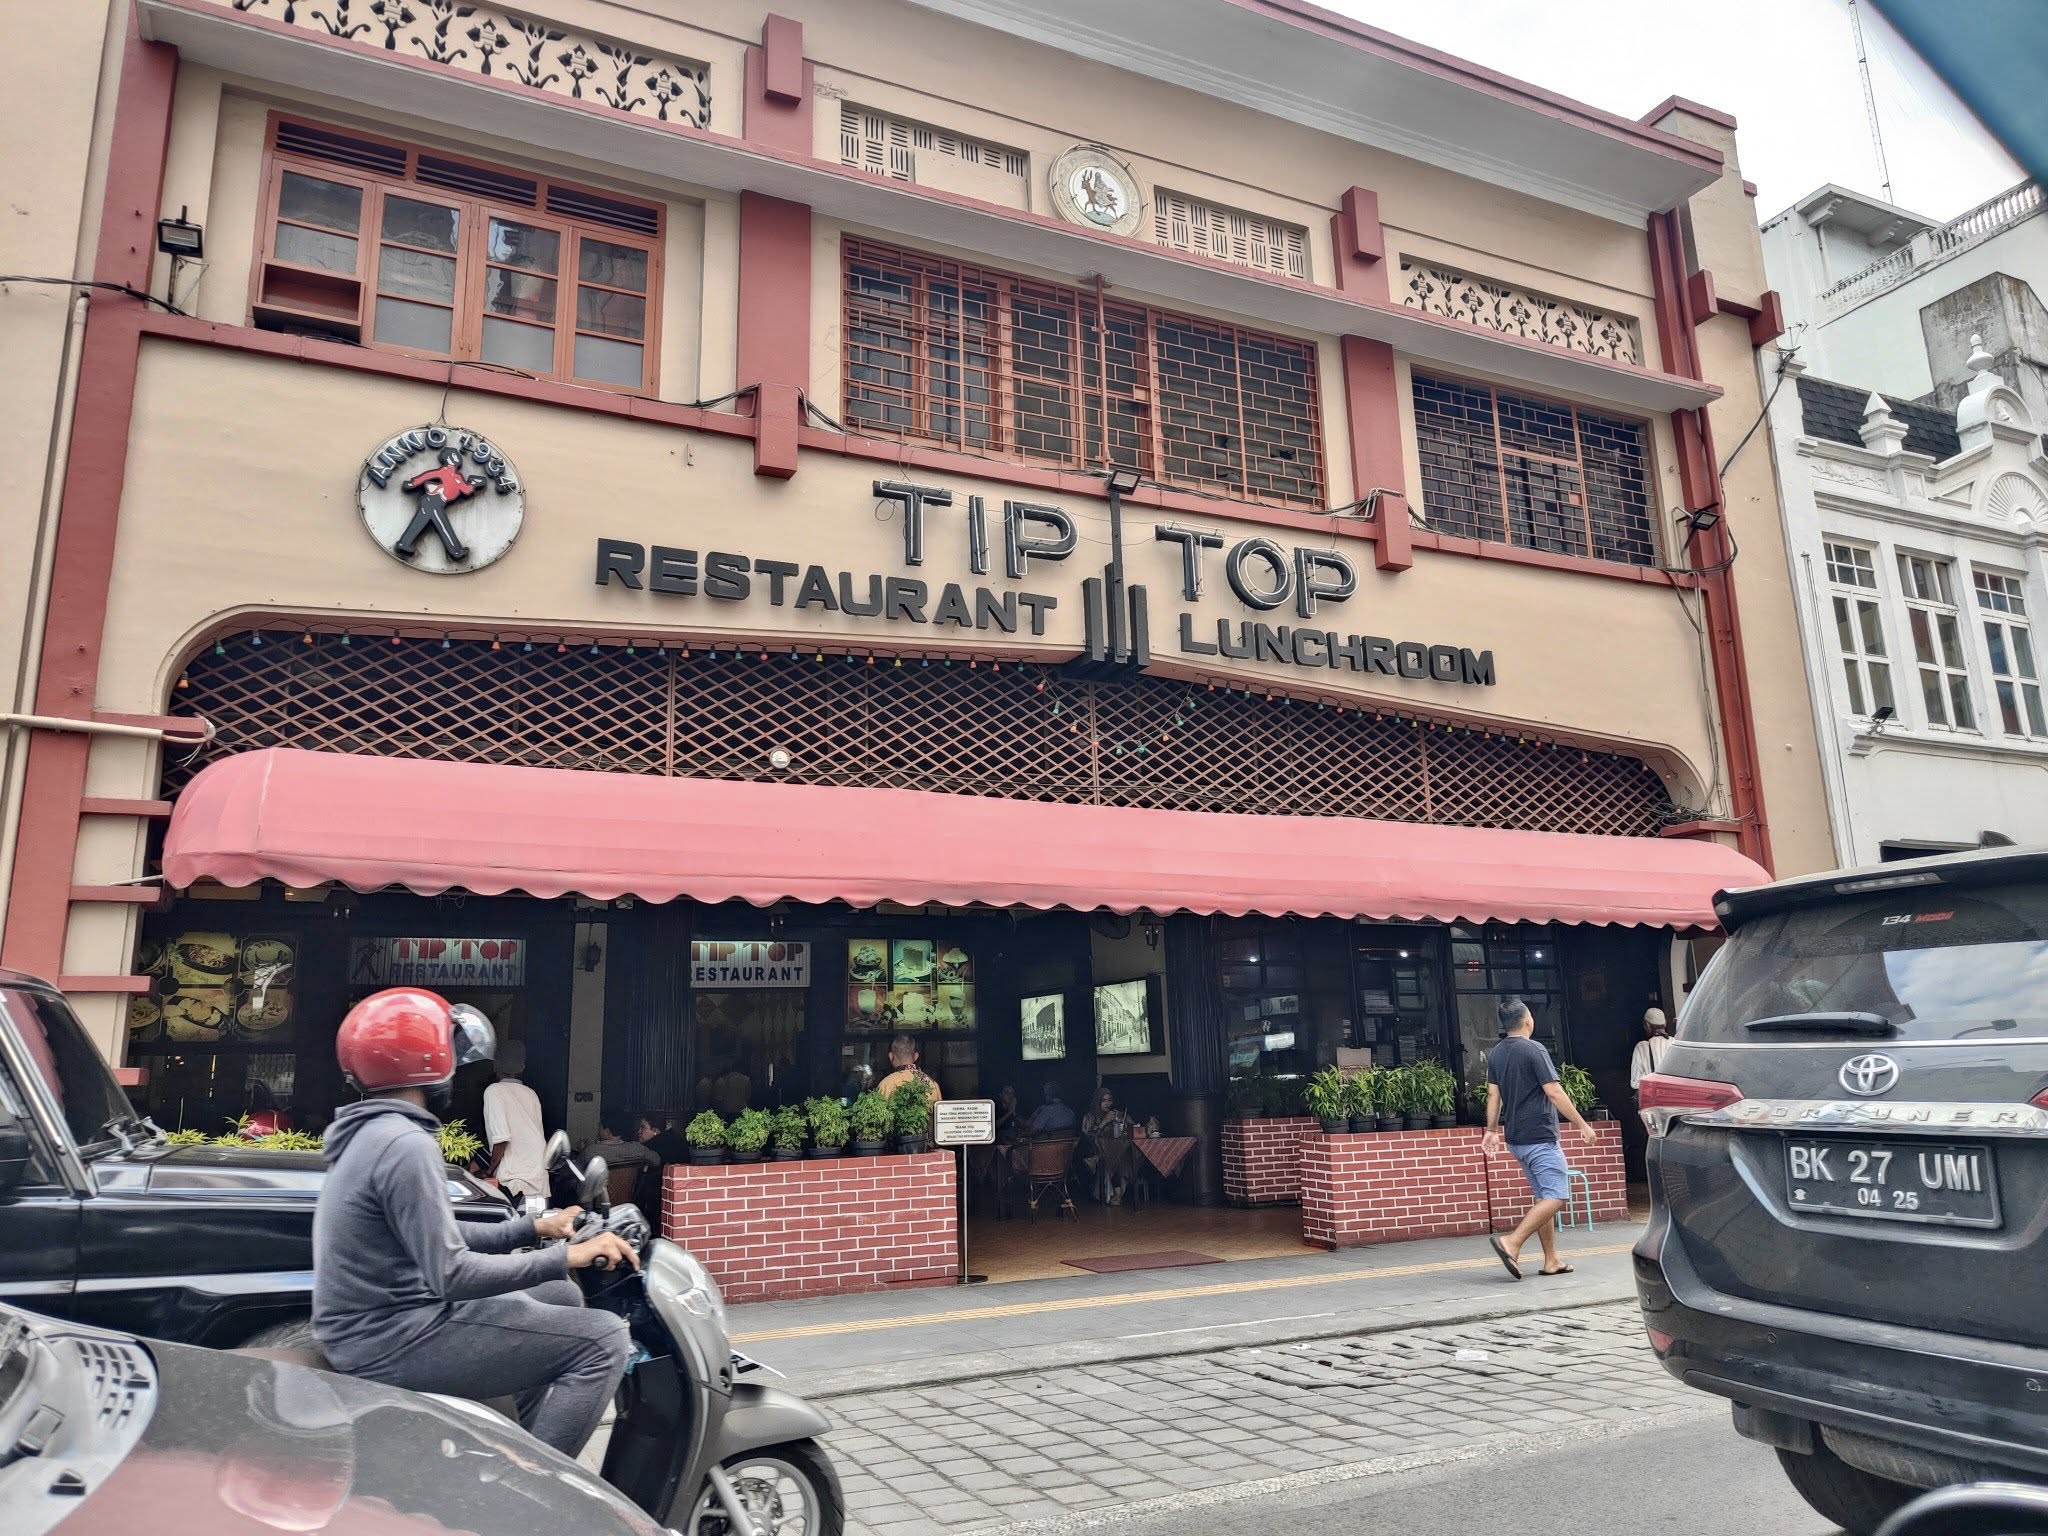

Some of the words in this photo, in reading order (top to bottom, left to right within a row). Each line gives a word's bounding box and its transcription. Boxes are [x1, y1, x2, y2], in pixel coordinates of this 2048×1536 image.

[368, 427, 447, 489] ANNO
[460, 434, 517, 495] 1934
[872, 478, 1079, 579] TIP
[1155, 519, 1360, 619] TOP
[595, 537, 1057, 636] RESTAURANT
[1179, 612, 1496, 686] LUNCHROOM
[1882, 914, 1912, 926] 134
[392, 939, 447, 960] TIP
[454, 940, 517, 960] TOP
[742, 943, 804, 961] TOP
[391, 963, 516, 979] RESTAURANT
[691, 967, 803, 981] ESTAURANT
[1743, 1105, 2019, 1123] FORTUNER
[1789, 1146, 1835, 1182] BK
[1848, 1150, 1893, 1185] 27
[1918, 1153, 1982, 1192] UMI
[1857, 1187, 1882, 1207] 04
[1892, 1190, 1919, 1210] 25
